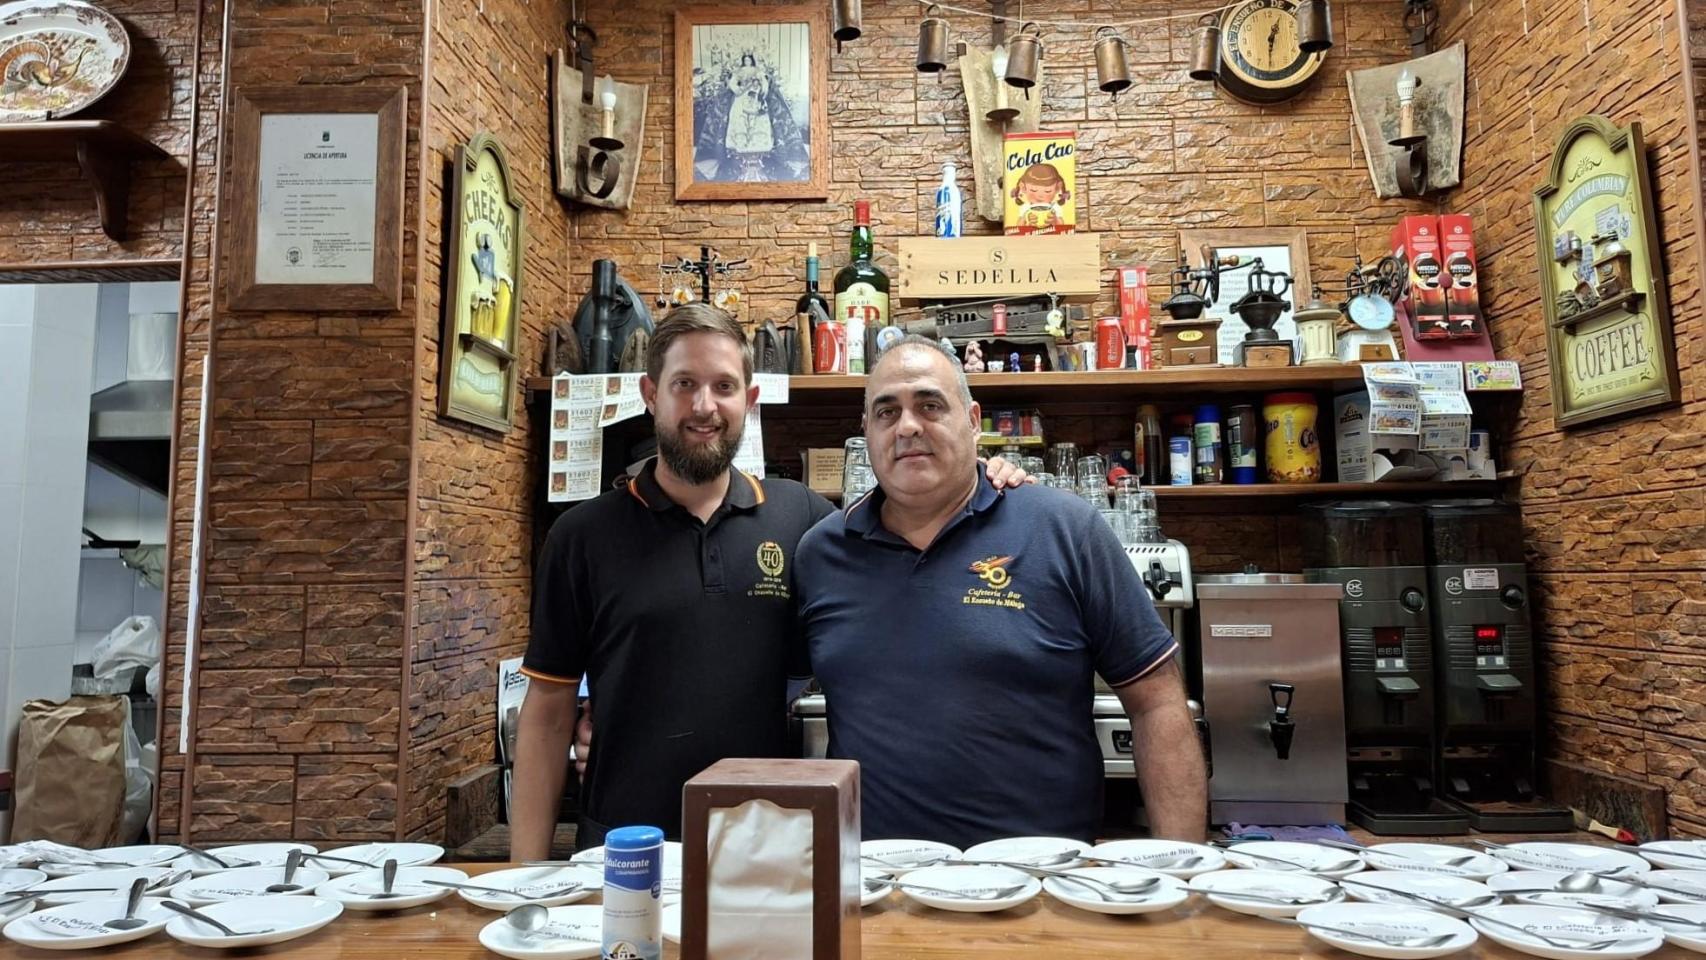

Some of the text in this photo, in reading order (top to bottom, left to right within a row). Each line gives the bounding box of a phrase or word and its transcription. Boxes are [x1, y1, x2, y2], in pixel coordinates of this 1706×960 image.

[1007, 142, 1074, 171] Cola Cao
[465, 189, 512, 250] CHEERS
[993, 250, 1003, 262] S
[938, 268, 1058, 285] SEDELLA
[1576, 321, 1648, 381] COFFEE
[763, 551, 779, 567] 40
